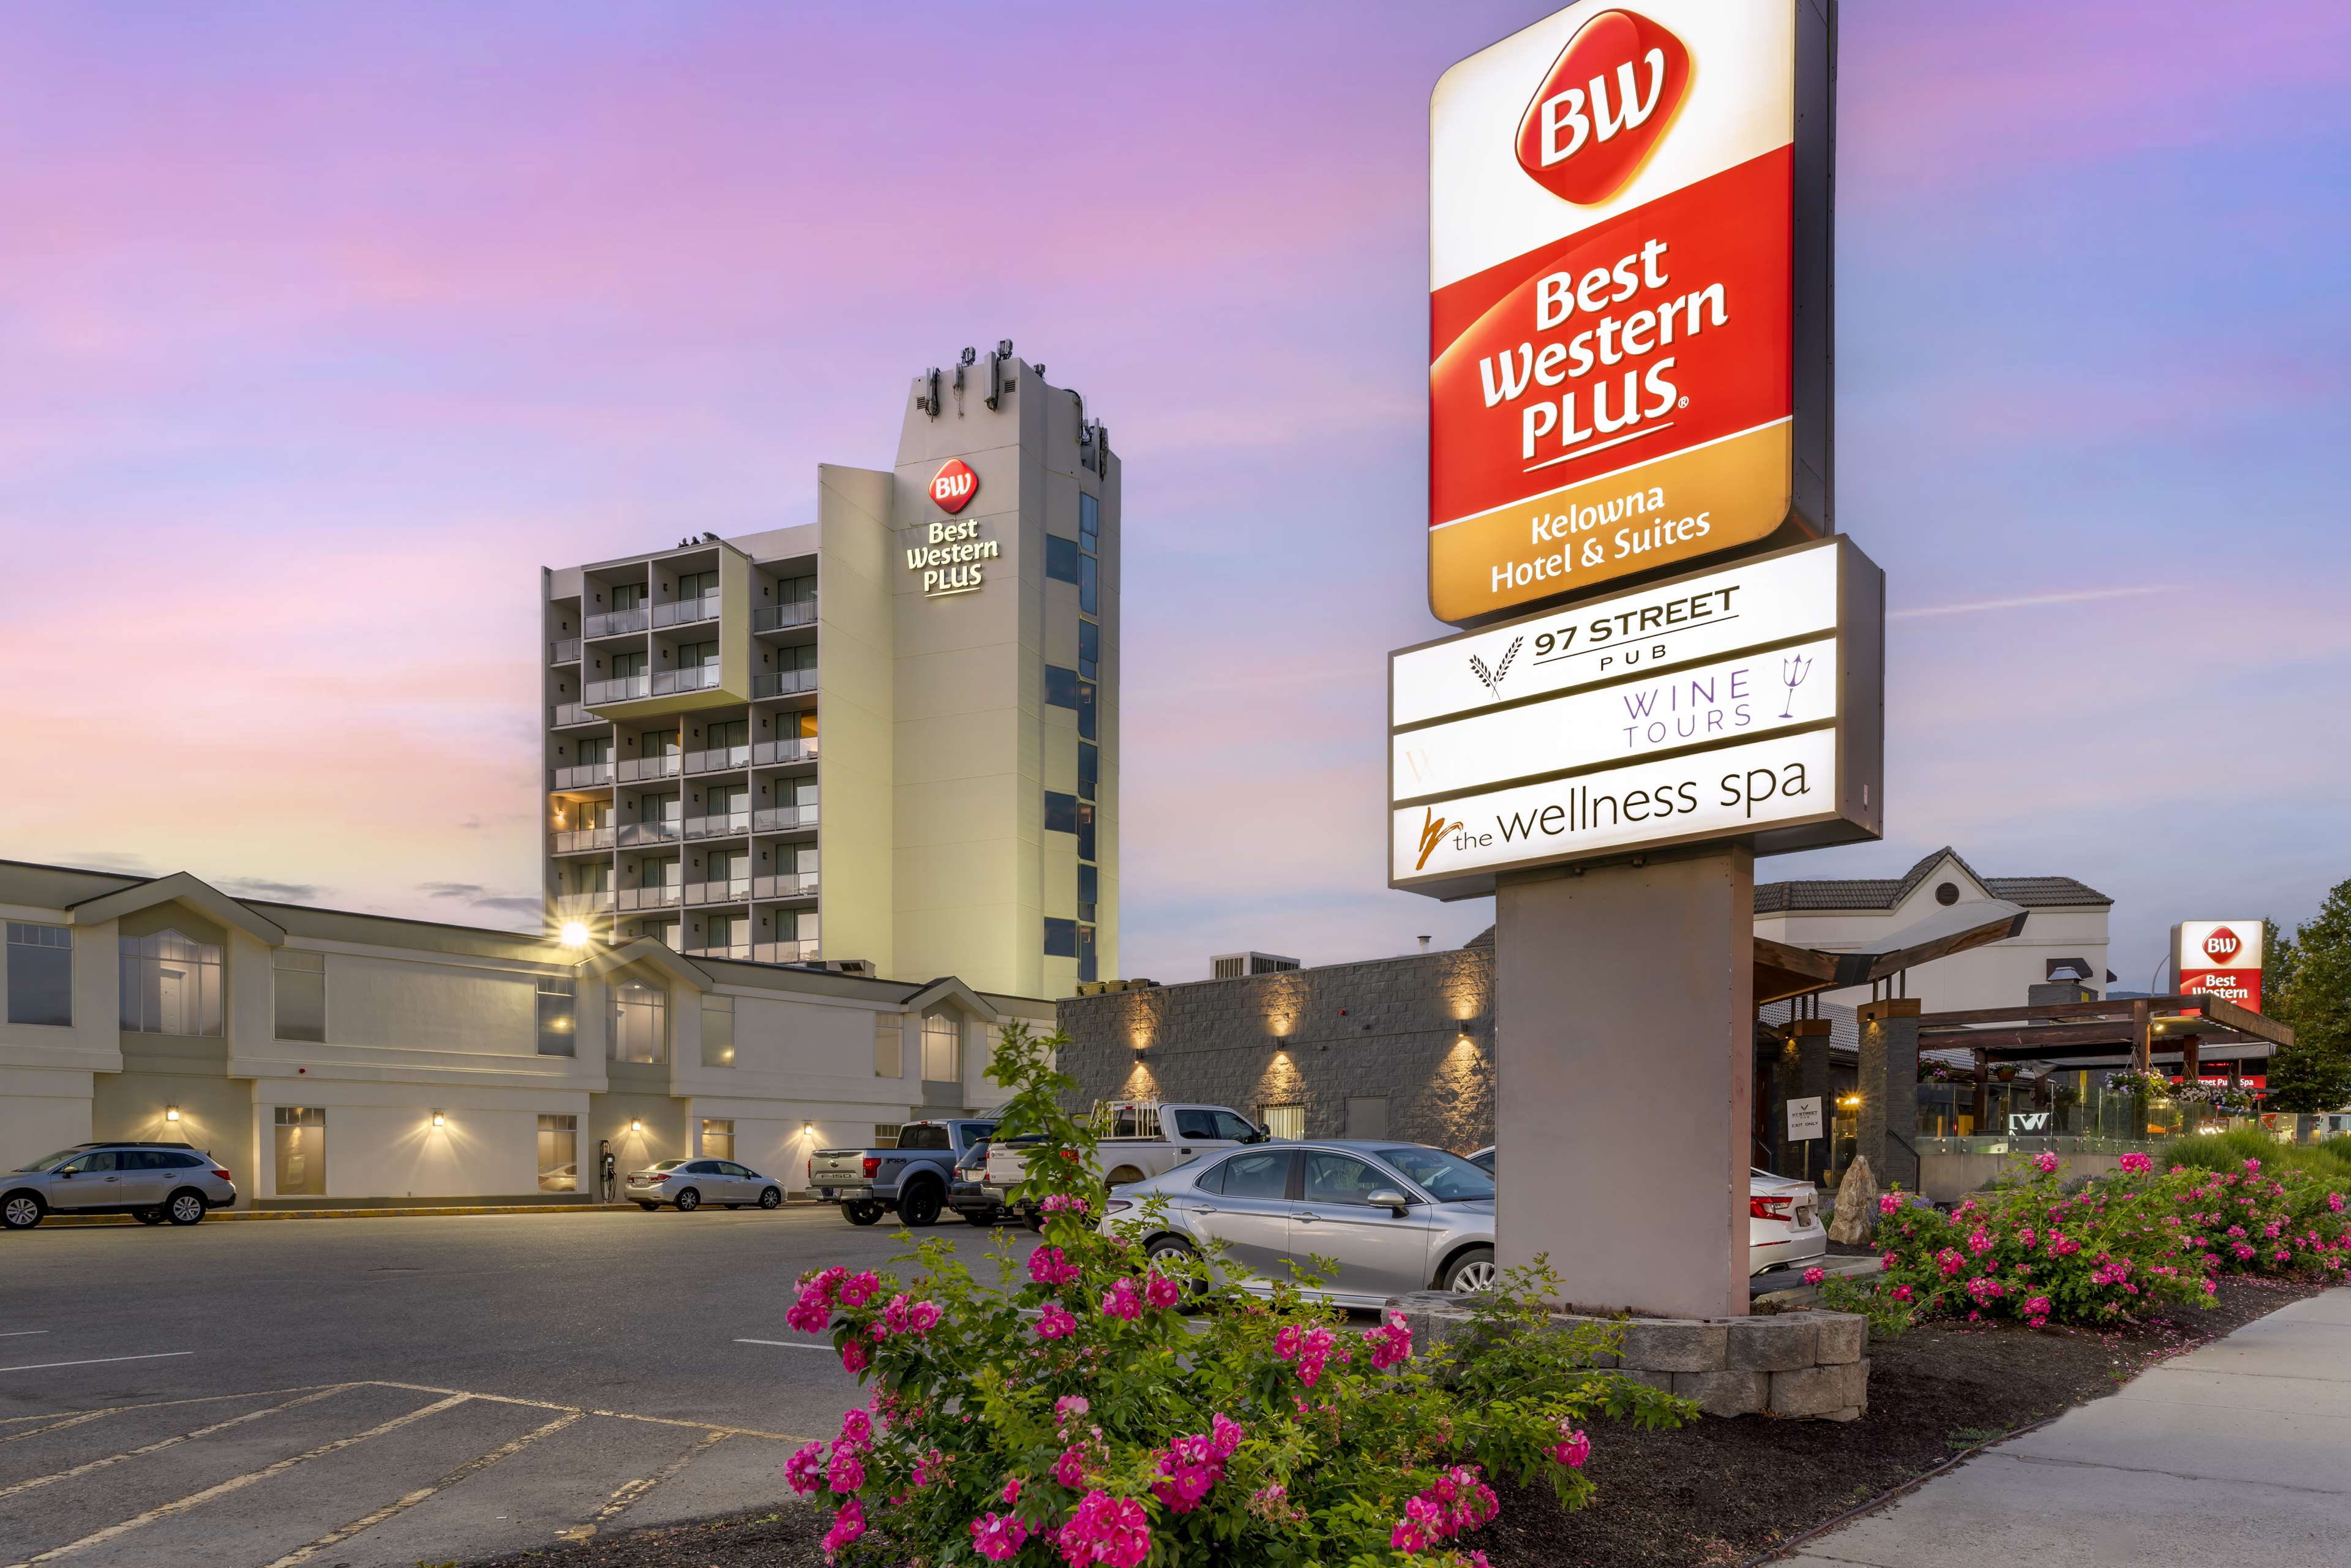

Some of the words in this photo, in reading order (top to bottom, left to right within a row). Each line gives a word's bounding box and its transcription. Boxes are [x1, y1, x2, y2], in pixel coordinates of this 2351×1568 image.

[1541, 47, 1665, 167] BW
[1536, 238, 1668, 332] Best
[1479, 282, 1728, 408] Western
[936, 473, 971, 499] BW
[929, 519, 978, 544] Best
[1531, 486, 1665, 544] Kelowna
[907, 539, 999, 570] Western
[1491, 542, 1572, 593] Hotel
[1580, 539, 1605, 567] &
[1613, 511, 1711, 559] Suites
[924, 563, 982, 592] PLUS
[1534, 626, 1579, 656] 97
[1589, 585, 1740, 642] STREET
[1600, 644, 1667, 672] PUB
[1623, 669, 1750, 720] WINE
[1622, 703, 1751, 748] TOURS
[1453, 827, 1493, 852] the
[1496, 781, 1697, 844] wellness
[1720, 760, 1811, 818] spa
[2208, 938, 2237, 953] BW
[2206, 975, 2236, 986] Best
[2240, 1078, 2254, 1087] Spa
